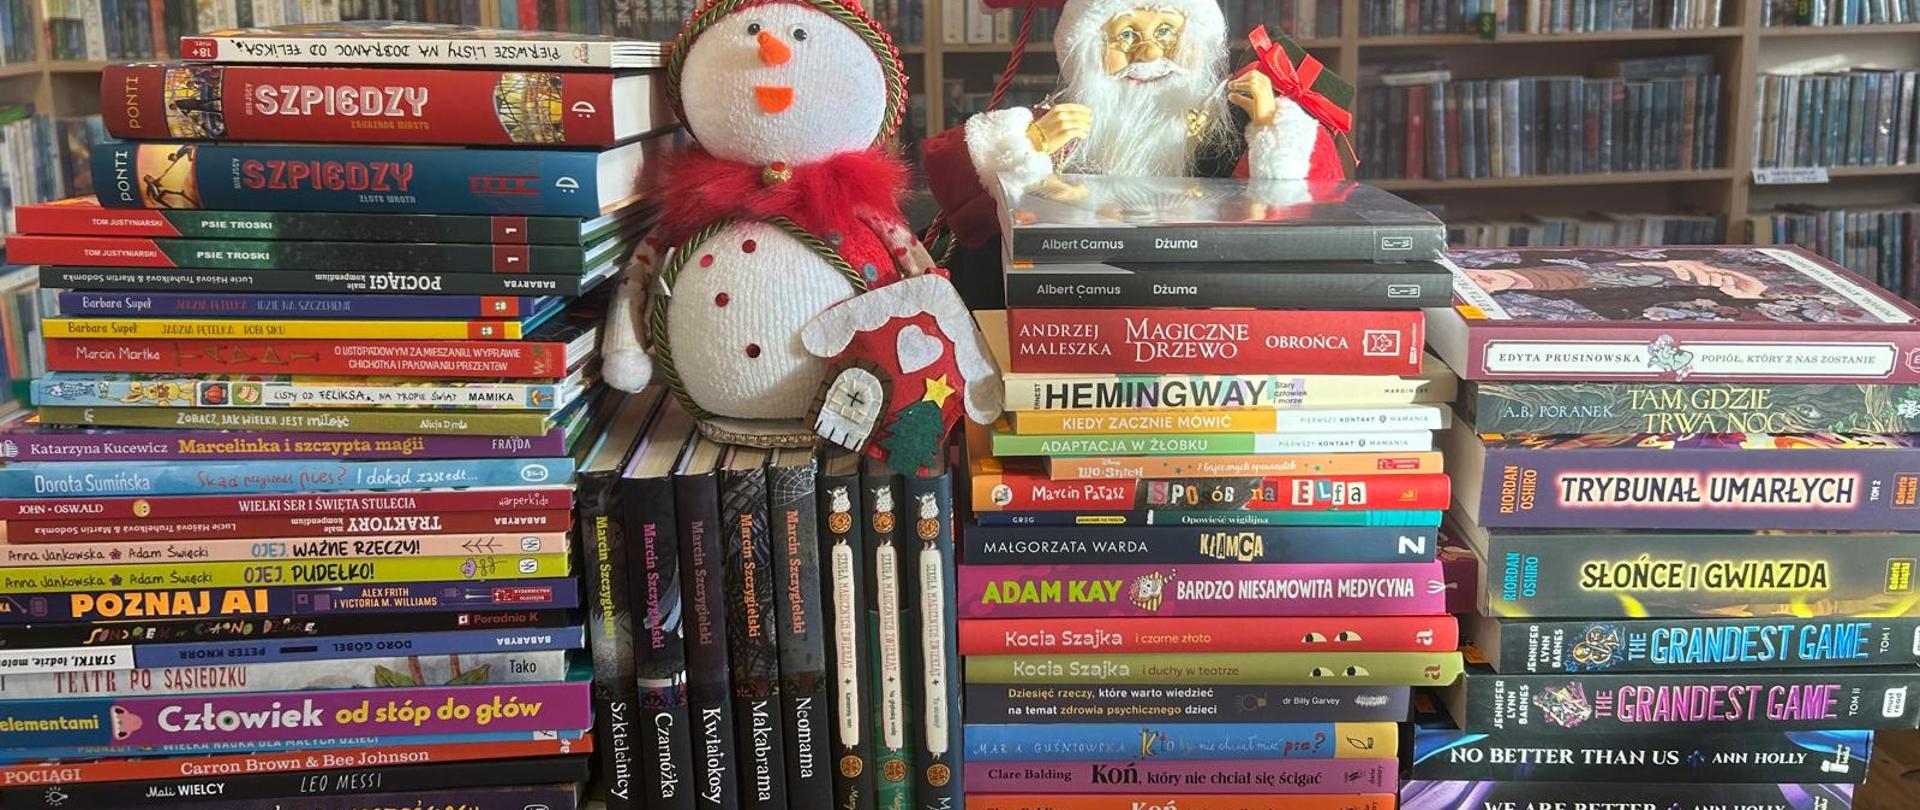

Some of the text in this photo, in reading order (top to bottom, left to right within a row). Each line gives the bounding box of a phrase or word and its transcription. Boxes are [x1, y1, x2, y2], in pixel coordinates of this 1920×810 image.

[192, 47, 211, 58] 18+
[125, 76, 142, 129] PONTI
[255, 84, 428, 117] SZPIEDZY
[115, 151, 133, 201] PONTI
[242, 160, 414, 191] SZPIEDZY
[92, 218, 163, 228] TOM JUSTYNIARSKI
[201, 220, 272, 229] PSIE TROSKI
[1041, 238, 1124, 250] Albert Camus
[1155, 238, 1198, 250] Dżuma
[197, 251, 270, 260] PSIE TROSKI
[370, 272, 442, 290] POCIĄGI
[504, 280, 556, 288] BABARYBA
[1036, 284, 1121, 295] Albert Camus
[1153, 284, 1197, 295] Dżuma
[1019, 324, 1099, 340] ANDRZEJ
[1125, 317, 1249, 344] MAGICZNE
[1020, 342, 1112, 356] MALESZKA
[1265, 334, 1348, 349] OBROŃCA
[76, 347, 160, 360] Marcin Mortka
[1131, 341, 1238, 363] DRZEWO
[1499, 353, 1641, 363] EDYTA PRUSINOWSKA
[1046, 380, 1266, 409] HEMINGWAY
[1628, 388, 1772, 412] TAM, GDZIE
[1063, 413, 1232, 430] KIEDY ZACZNIE MÓWIĆ
[1503, 405, 1614, 418] A.B. PORANEK
[1643, 412, 1787, 434] TRWA NOC
[31, 442, 168, 456] Katarzyna Kucewicz
[178, 437, 424, 458] Marcelinka i szczypta magii
[1041, 437, 1208, 452] ADAPTACJA W ŻŁOBKU
[34, 473, 150, 493] Dorota Sumińska
[1033, 486, 1079, 500] Marcin
[1500, 465, 1518, 514] RIORDAN
[1520, 469, 1537, 510] OSHIRO
[1561, 477, 1855, 503] TRYBUNAŁ UMARŁYCH
[1871, 486, 1881, 501] TOM
[238, 496, 416, 512] WIELKI SER I ŚWIĘTA STULECIA
[347, 516, 442, 531] TRAKTORY
[494, 516, 547, 525] BABARYBA
[596, 515, 609, 561] Marcin
[983, 540, 1149, 553] MAŁGORZATA WARDA
[8, 548, 105, 562] Anna Jankowska
[128, 544, 209, 559] Adam Święcki
[130, 569, 213, 584] Adam Święcki
[741, 513, 760, 637] Marcin Szczygielski
[786, 509, 808, 634] Marcin Szczygielski
[1503, 552, 1520, 602] RIORDAN
[1523, 556, 1538, 597] OSHIRO
[1582, 553, 1828, 588] SŁOŃCE GWIAZDA
[5, 575, 105, 589] Anna Jankowska
[361, 587, 409, 597] ALEX FRITH
[981, 580, 1123, 604] ADAM KAY
[1177, 578, 1414, 600] BARDZO NIESAMOWITA MEDYCYNA
[71, 589, 269, 618] POZNAJ AI
[1527, 625, 1539, 672] JENNIFER
[1540, 635, 1550, 662] LYNN
[1552, 629, 1563, 668] BARNES
[1628, 632, 1646, 661] THE
[1650, 624, 1795, 664] GRANDEST
[1799, 623, 1872, 660] GAME
[1880, 632, 1890, 653] TOM
[180, 647, 265, 659] PETER KNORR
[510, 660, 536, 674] Tako
[1013, 661, 1064, 677] Kocia
[1070, 660, 1130, 680] Szajka
[1142, 666, 1145, 676] i
[1149, 665, 1181, 678] duchy
[1200, 666, 1239, 676] teatrze
[53, 666, 247, 693] TEATR PO SĄSIEDZKU
[1008, 688, 1213, 701] Dziesięć rzeczy, które warto wiedzieć
[1282, 697, 1340, 706] dr Billy Garvey
[1494, 680, 1504, 729] JENNIFER
[1519, 684, 1529, 725] BARNES
[1595, 685, 1841, 723] THE GRANDEST GAME
[158, 695, 542, 733] Człowiek od stóp do głów
[1008, 705, 1217, 716] na temat zdrowia psychicznego dzieci
[1507, 691, 1516, 719] LYNN
[1849, 696, 1859, 716] TOM
[180, 750, 429, 775] Carron Brown & Bee Johnson
[1450, 748, 1680, 765] NO BETTER THAN US
[1712, 753, 1807, 764] ANN HOLLY
[301, 772, 381, 792] LEO MESSI
